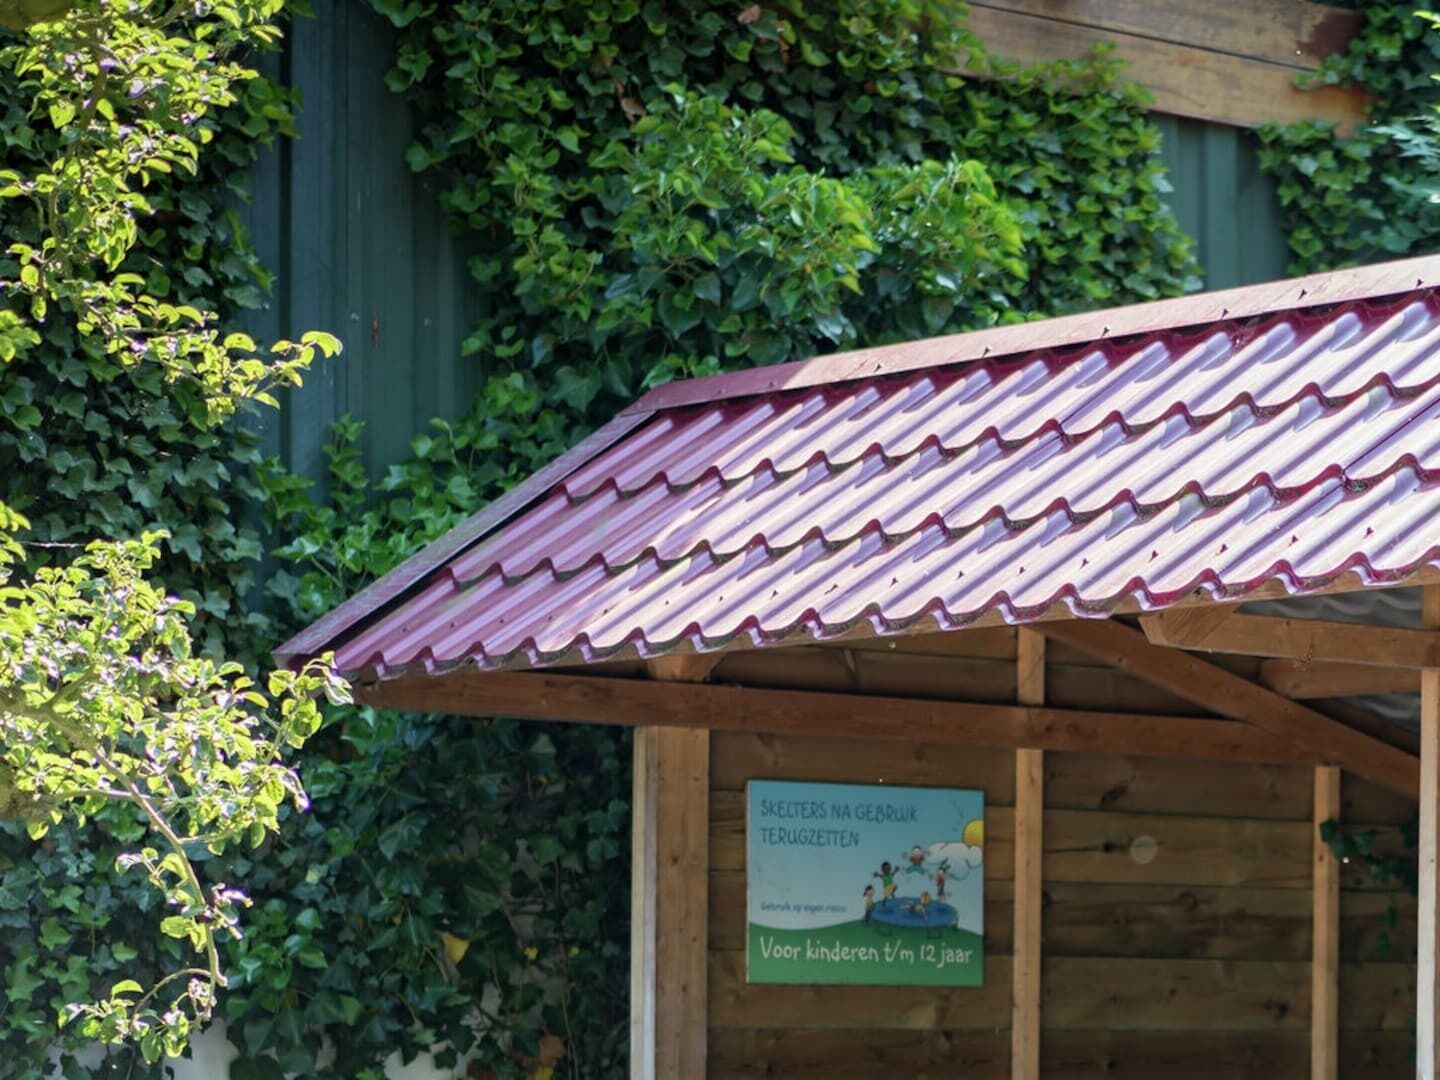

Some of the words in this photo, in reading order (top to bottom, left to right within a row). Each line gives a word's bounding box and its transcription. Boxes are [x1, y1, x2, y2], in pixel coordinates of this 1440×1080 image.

[760, 799, 827, 820] SKELTERS
[831, 803, 852, 821] NA
[855, 803, 918, 823] GEBRUIK
[760, 827, 859, 848] TERUGZETTEN
[760, 936, 801, 960] Voor
[806, 937, 880, 962] kinderen
[884, 939, 915, 964] t/m
[920, 943, 937, 961] 12
[937, 943, 973, 969] jaar
